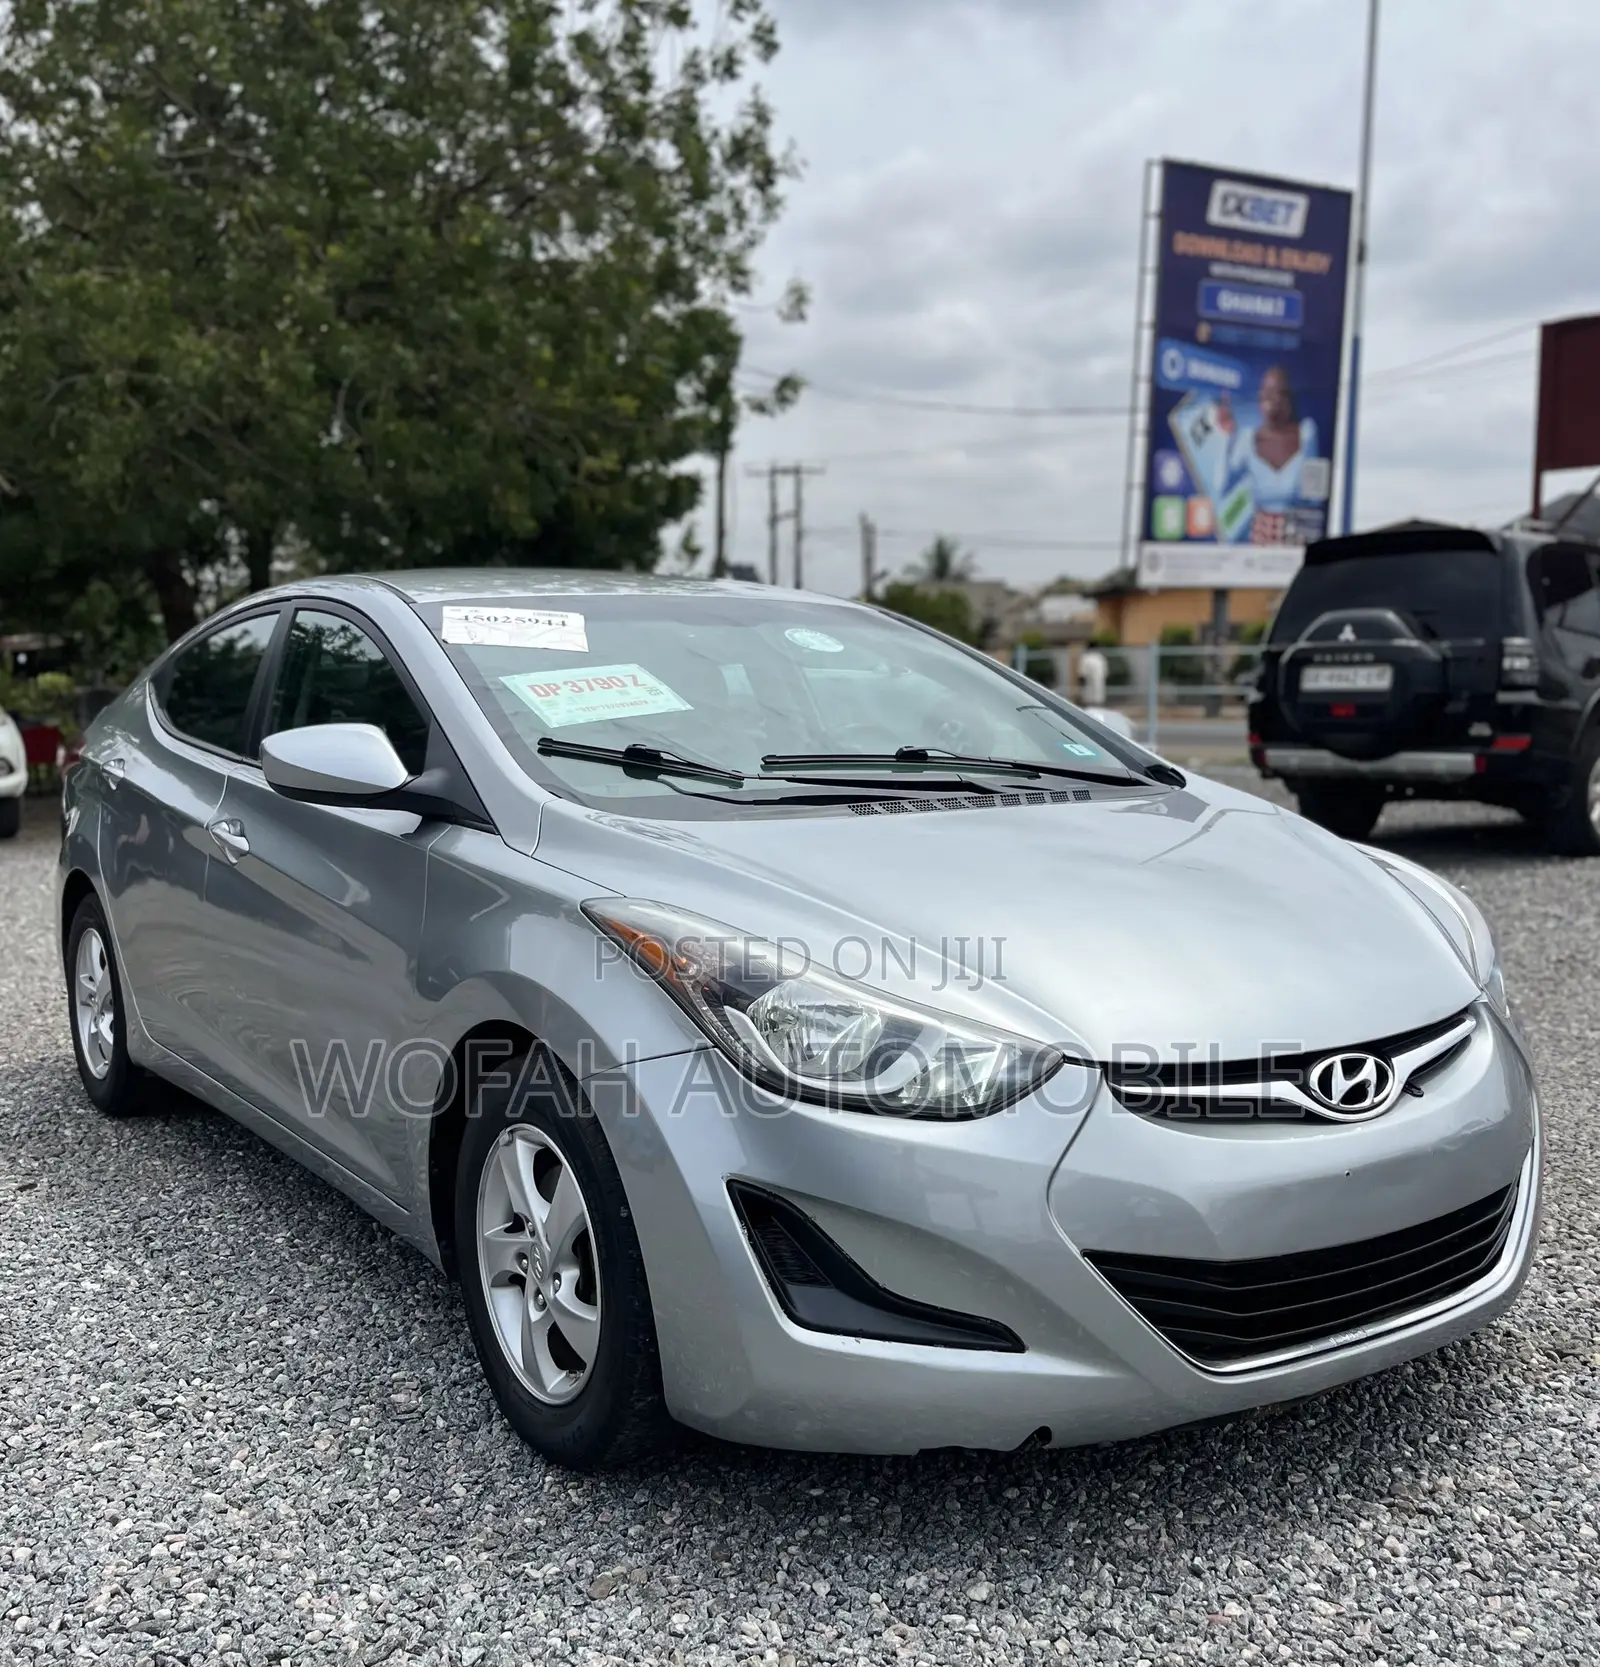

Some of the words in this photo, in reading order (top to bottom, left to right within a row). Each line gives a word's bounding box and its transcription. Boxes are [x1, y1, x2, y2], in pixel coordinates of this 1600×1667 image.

[461, 614, 568, 628] 45025944
[526, 682, 562, 699] DP
[568, 675, 628, 695] 3790
[624, 673, 648, 688] Z
